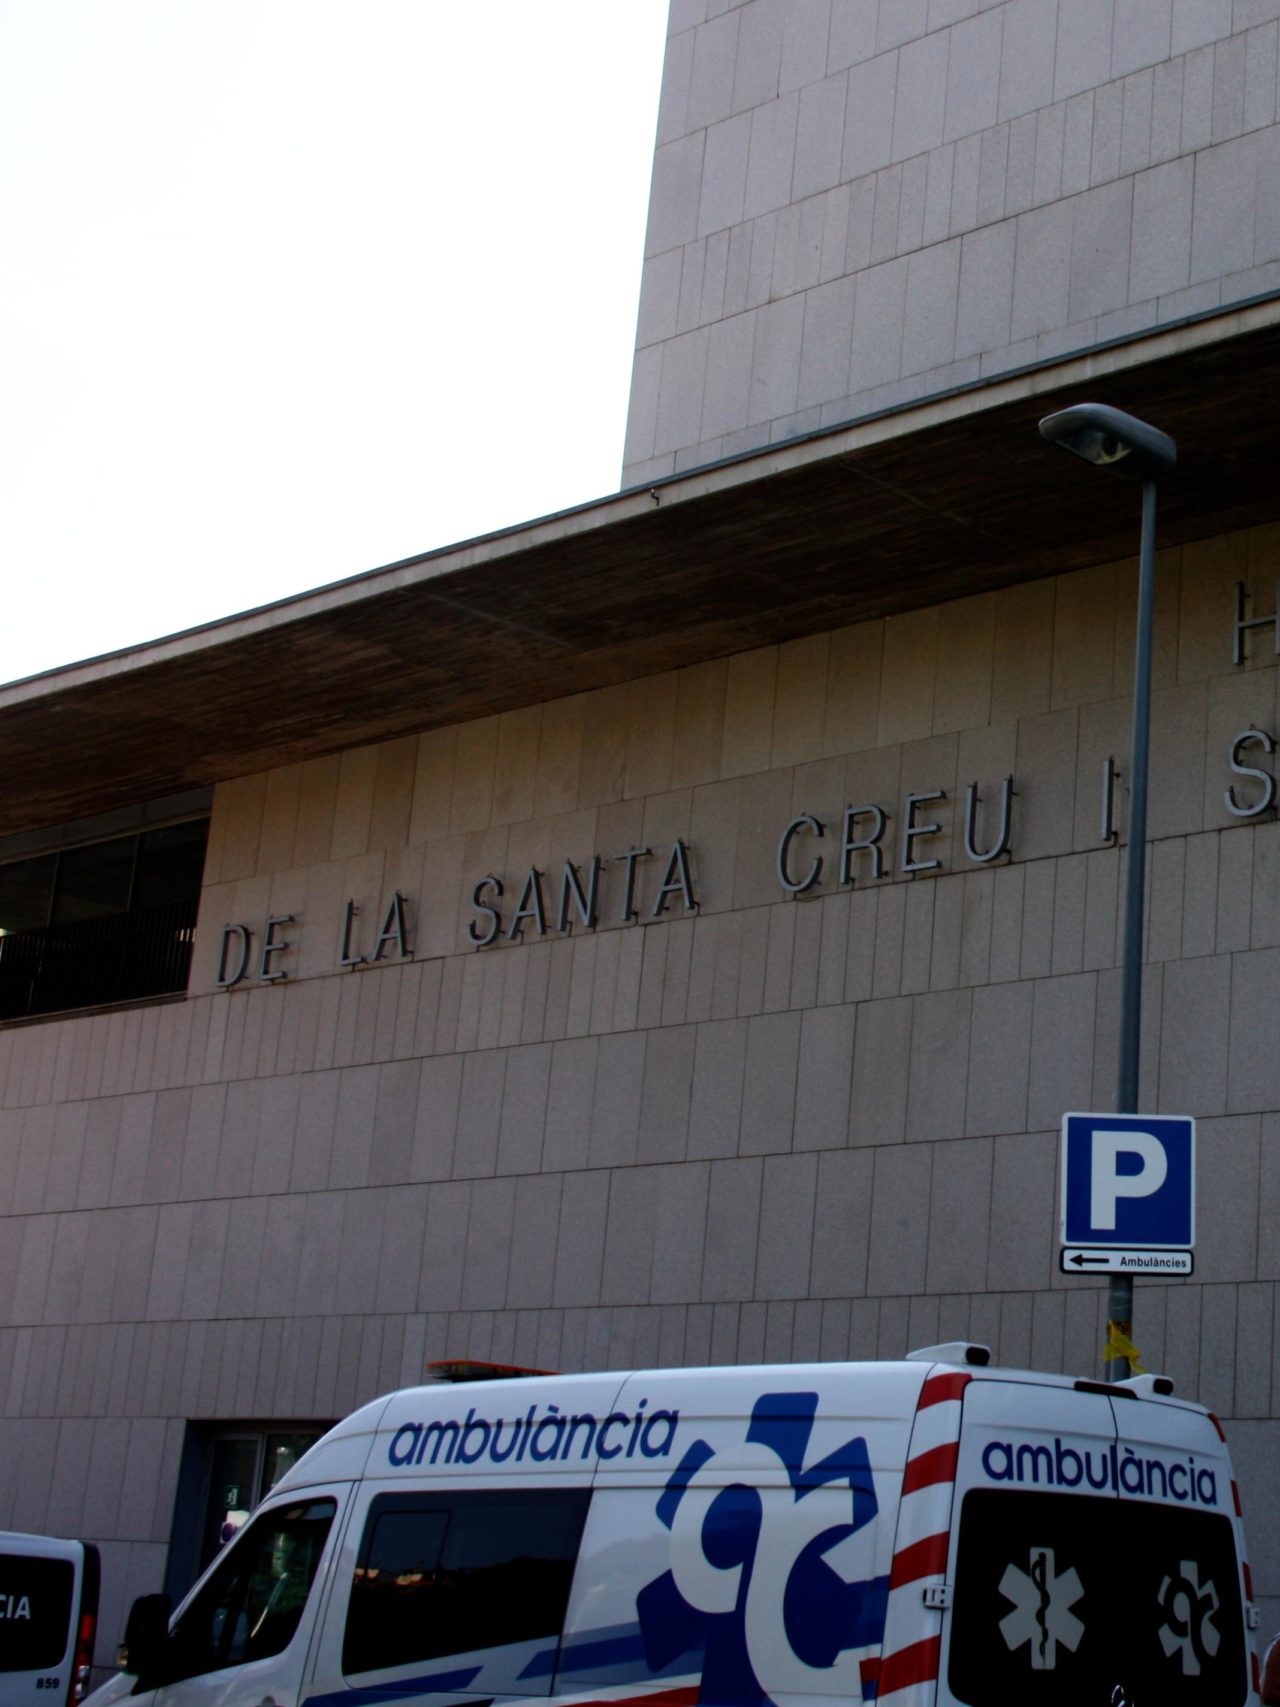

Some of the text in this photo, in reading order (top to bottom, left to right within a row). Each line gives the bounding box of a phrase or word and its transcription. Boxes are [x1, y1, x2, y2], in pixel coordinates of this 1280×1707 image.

[218, 914, 295, 987] DE
[340, 892, 414, 968] LA
[468, 838, 698, 948] SANTA
[777, 774, 1015, 893] CREU
[1102, 756, 1118, 843] I
[1090, 1130, 1168, 1230] P
[1120, 1256, 1187, 1268] Ambulàncies
[388, 1398, 679, 1467] ambulància
[982, 1438, 1217, 1505] ambulància
[36, 1678, 60, 1689] 859
